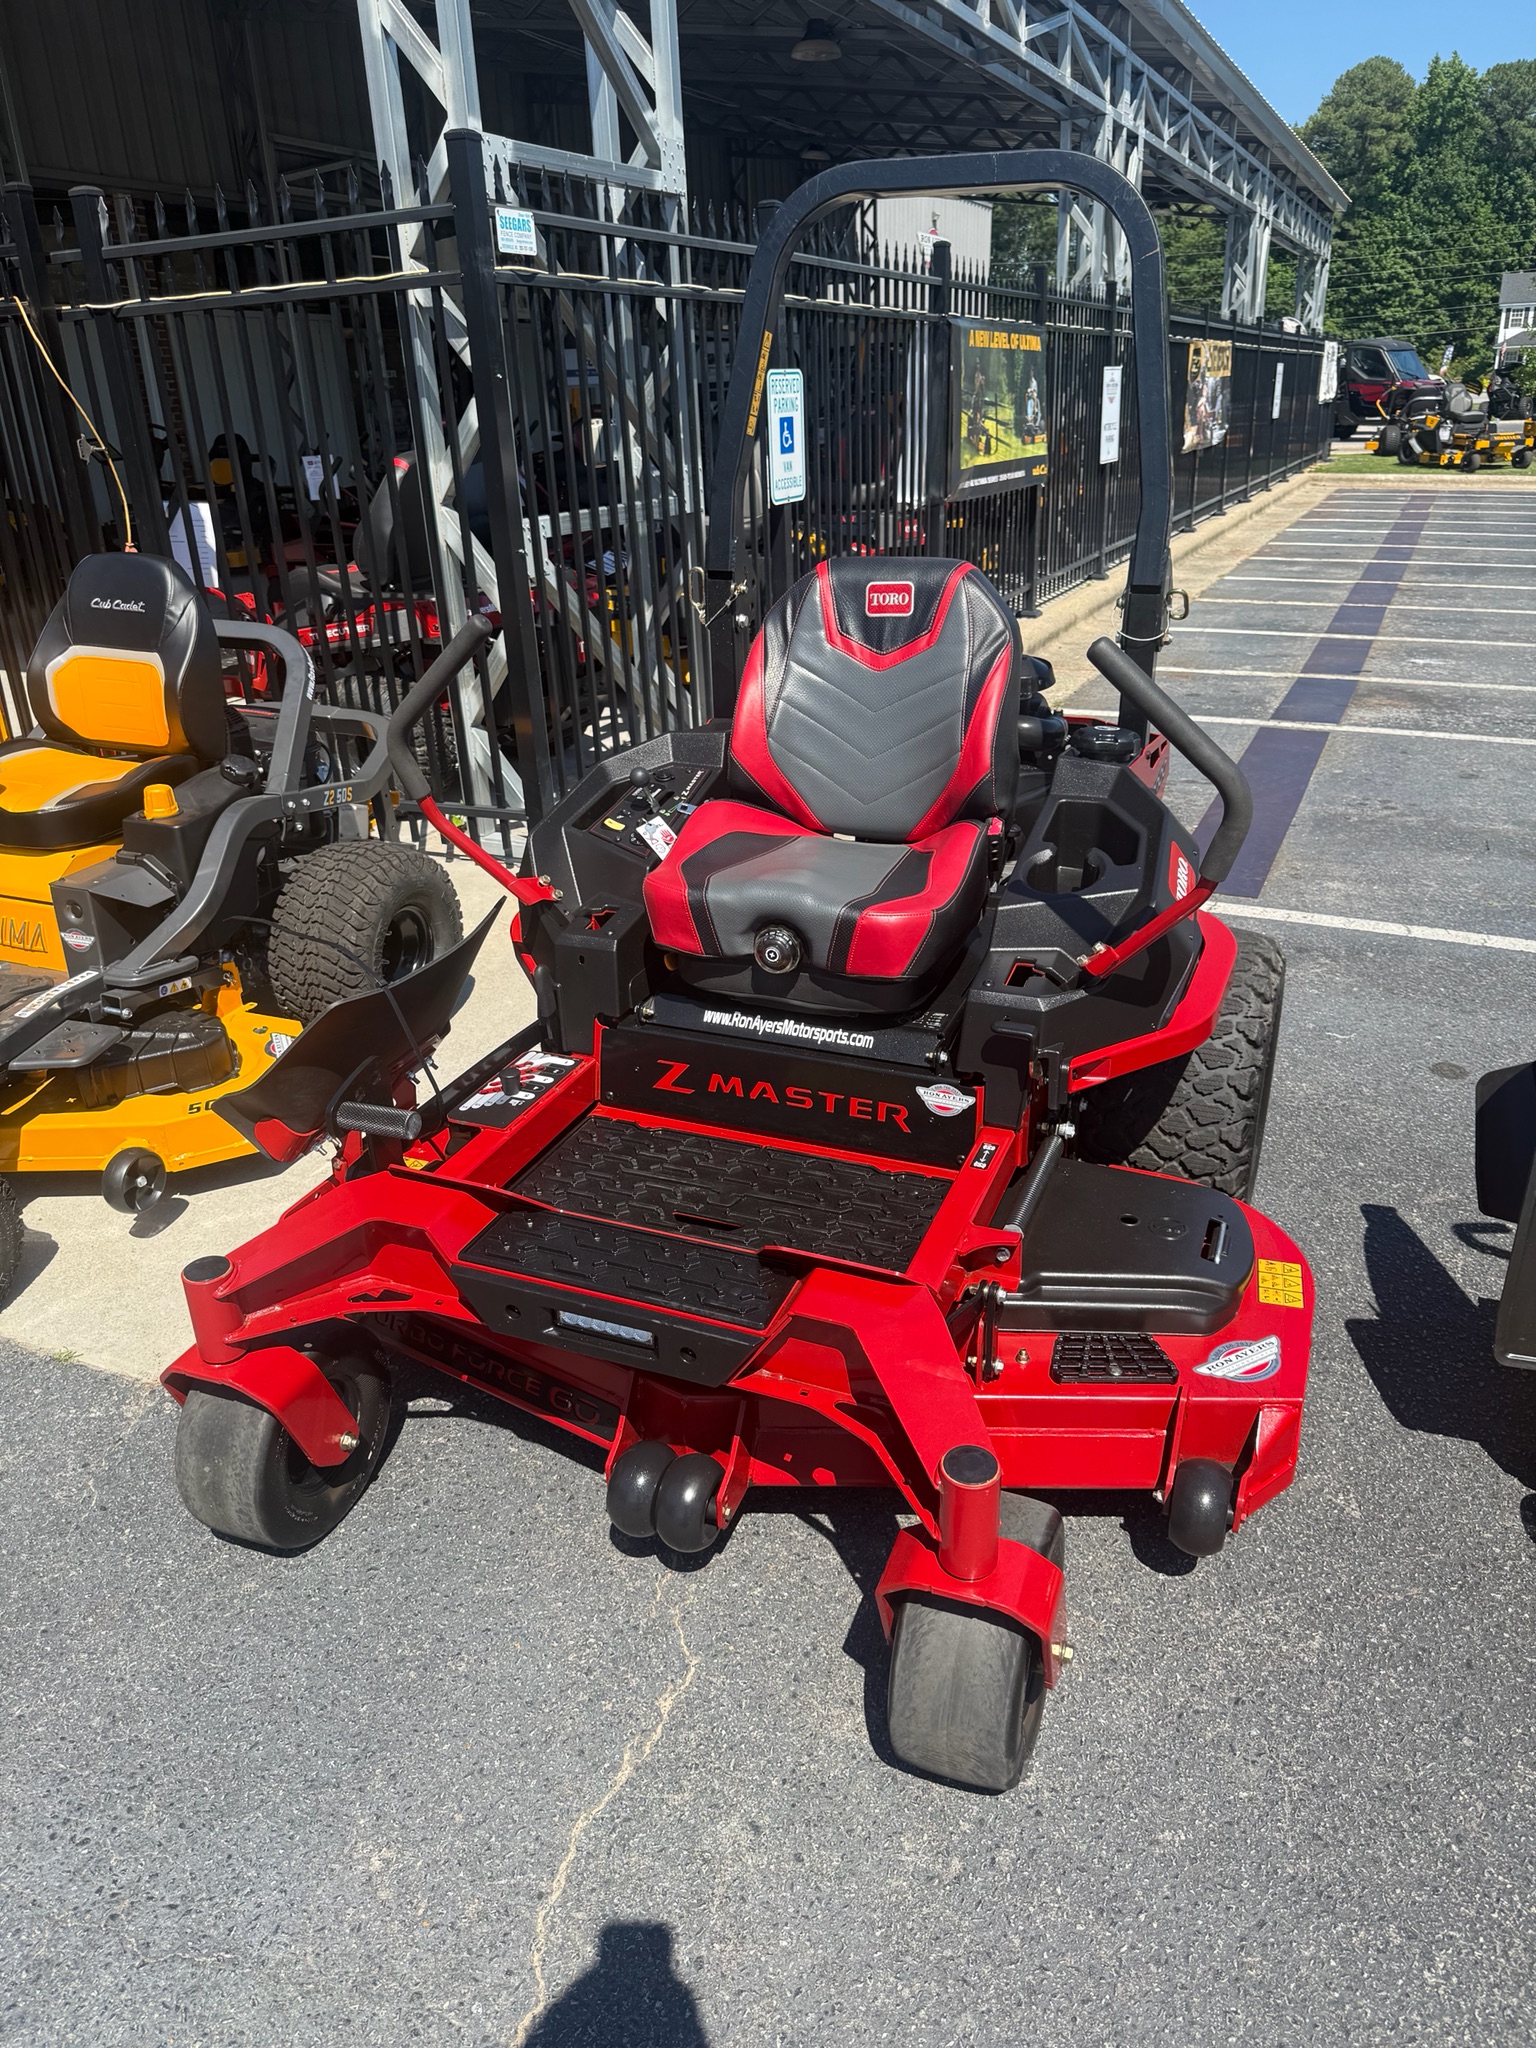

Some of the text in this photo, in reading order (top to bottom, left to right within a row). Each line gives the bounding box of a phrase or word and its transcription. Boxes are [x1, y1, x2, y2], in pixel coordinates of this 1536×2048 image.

[499, 215, 532, 233] SEEGARS
[500, 230, 514, 238] FENCE
[968, 329, 1042, 352] A NEW LEVEL OF ULTIMA
[771, 378, 800, 395] RESERVED
[773, 396, 799, 413] PARKING
[783, 460, 793, 473] VAN
[775, 475, 803, 491] ACCESSIBLE
[90, 597, 146, 613] Cub Cadet
[870, 592, 910, 606] TORO
[308, 622, 371, 643] TIECUTER
[323, 786, 353, 807] Z2 50S
[703, 1009, 875, 1049] www.RonAyersMotorsports.com
[652, 1059, 912, 1134] Z MASTER
[923, 1090, 940, 1098] RON
[941, 1093, 970, 1103] AYERS
[1206, 1341, 1275, 1371] RON AYERS
[374, 1311, 600, 1426] URBO FORCE 60
